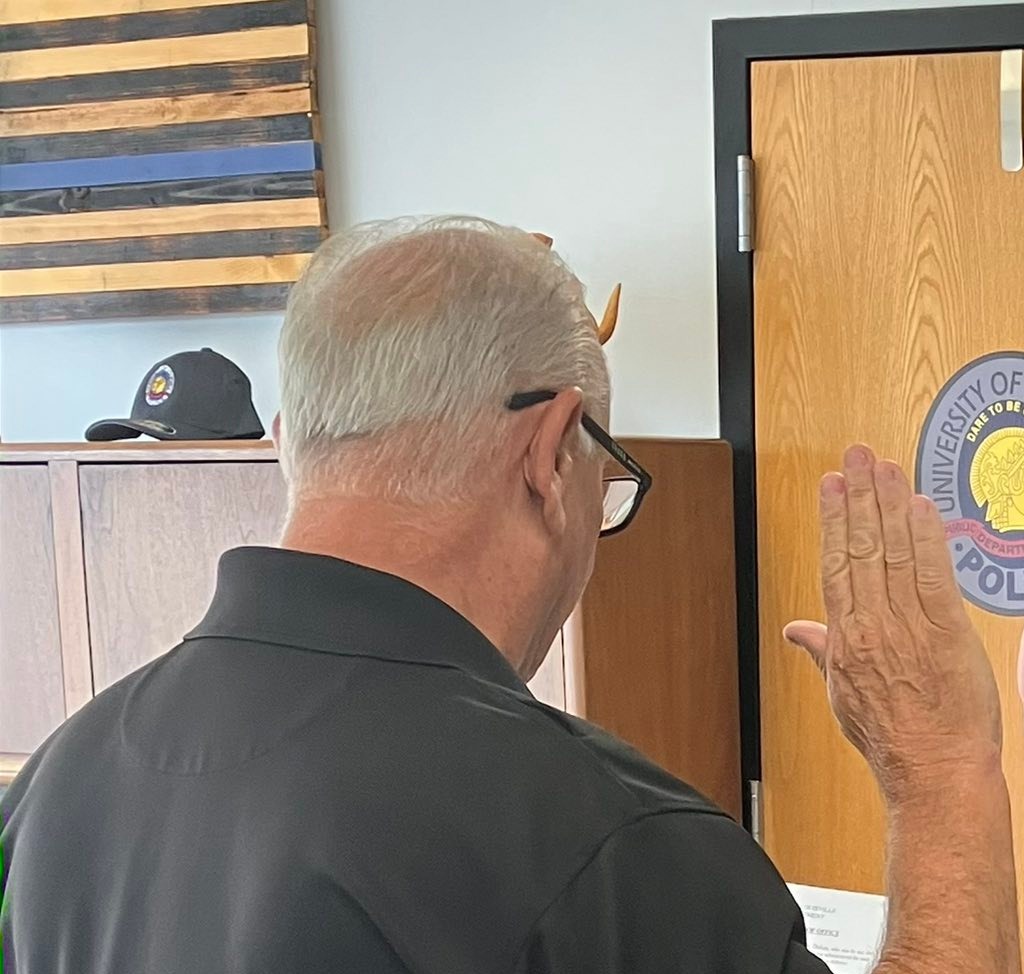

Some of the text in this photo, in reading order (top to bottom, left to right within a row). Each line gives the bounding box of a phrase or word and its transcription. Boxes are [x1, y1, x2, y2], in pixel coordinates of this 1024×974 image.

[932, 379, 985, 513] UNIVERSITY
[990, 371, 1023, 396] OF
[966, 412, 989, 442] DARE
[987, 402, 1004, 416] TO
[1006, 400, 1021, 412] BE
